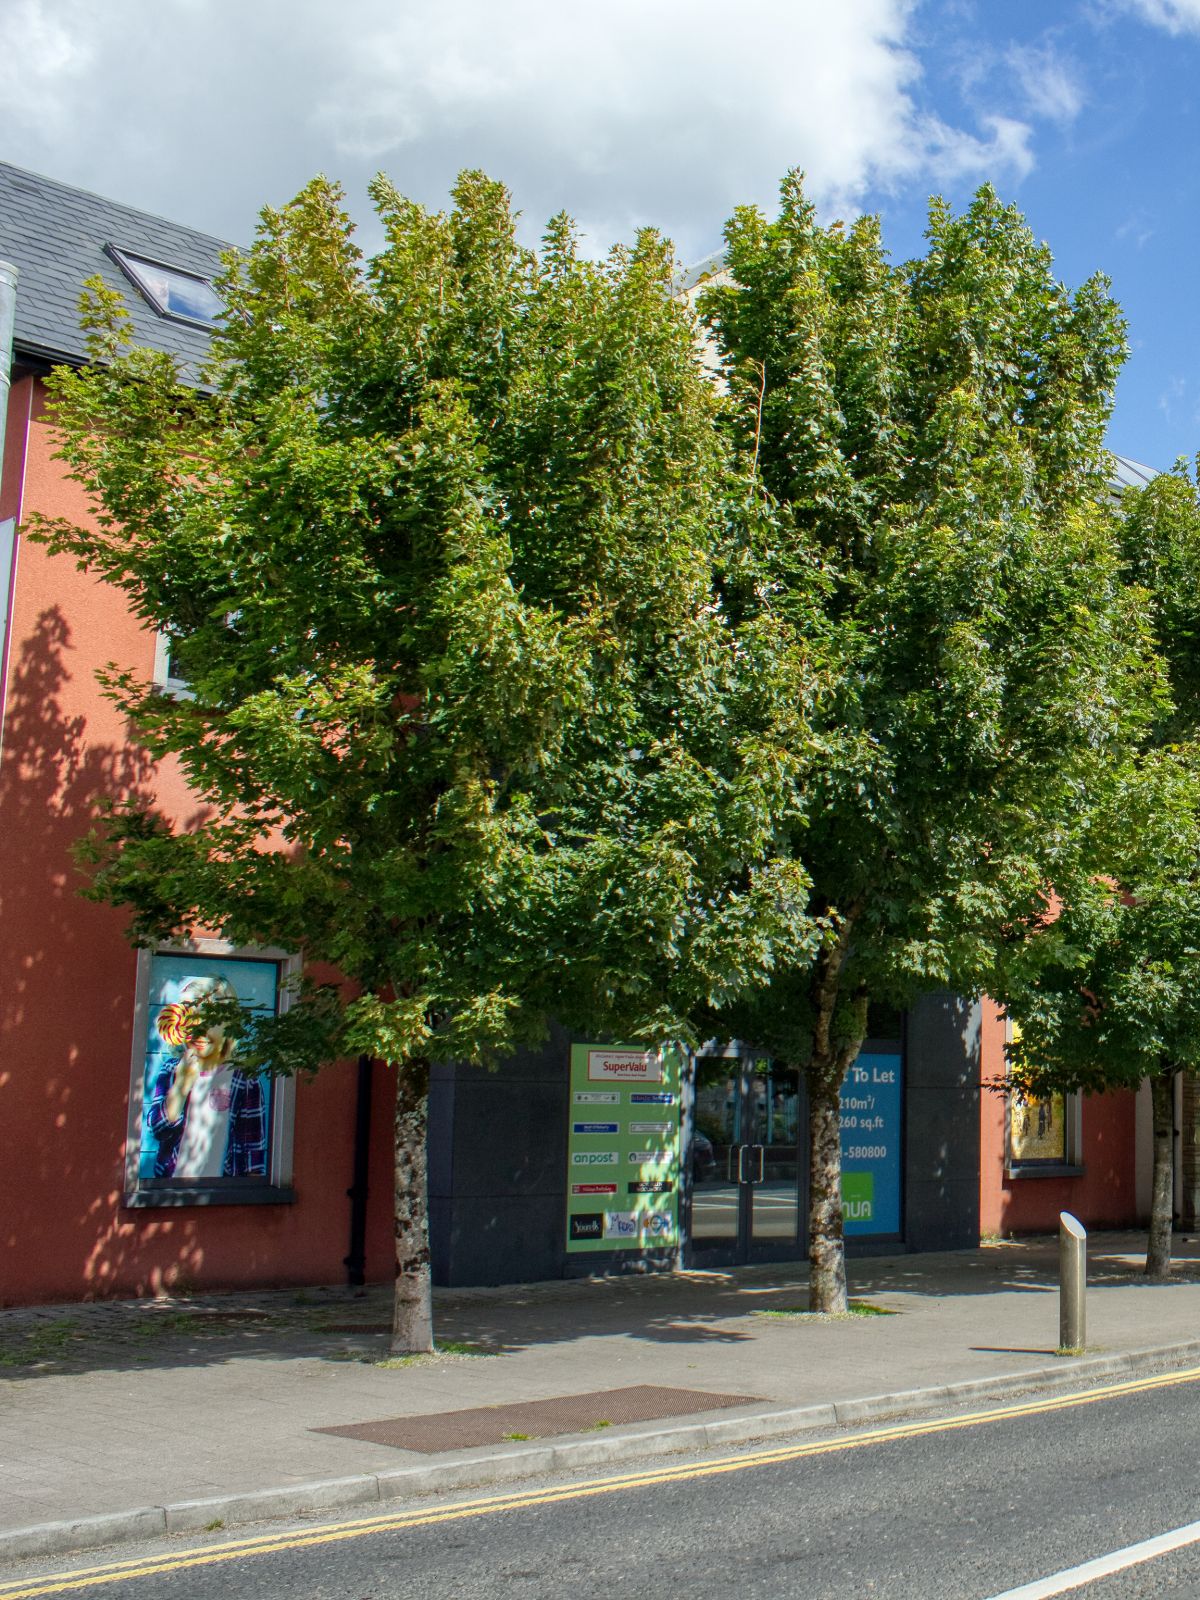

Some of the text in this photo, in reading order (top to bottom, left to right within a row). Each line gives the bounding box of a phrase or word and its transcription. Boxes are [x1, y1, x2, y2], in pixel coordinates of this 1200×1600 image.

[603, 1061, 647, 1074] SuperValu
[852, 1067, 869, 1083] To
[873, 1067, 895, 1083] Let
[839, 1146, 887, 1158] 1-580800
